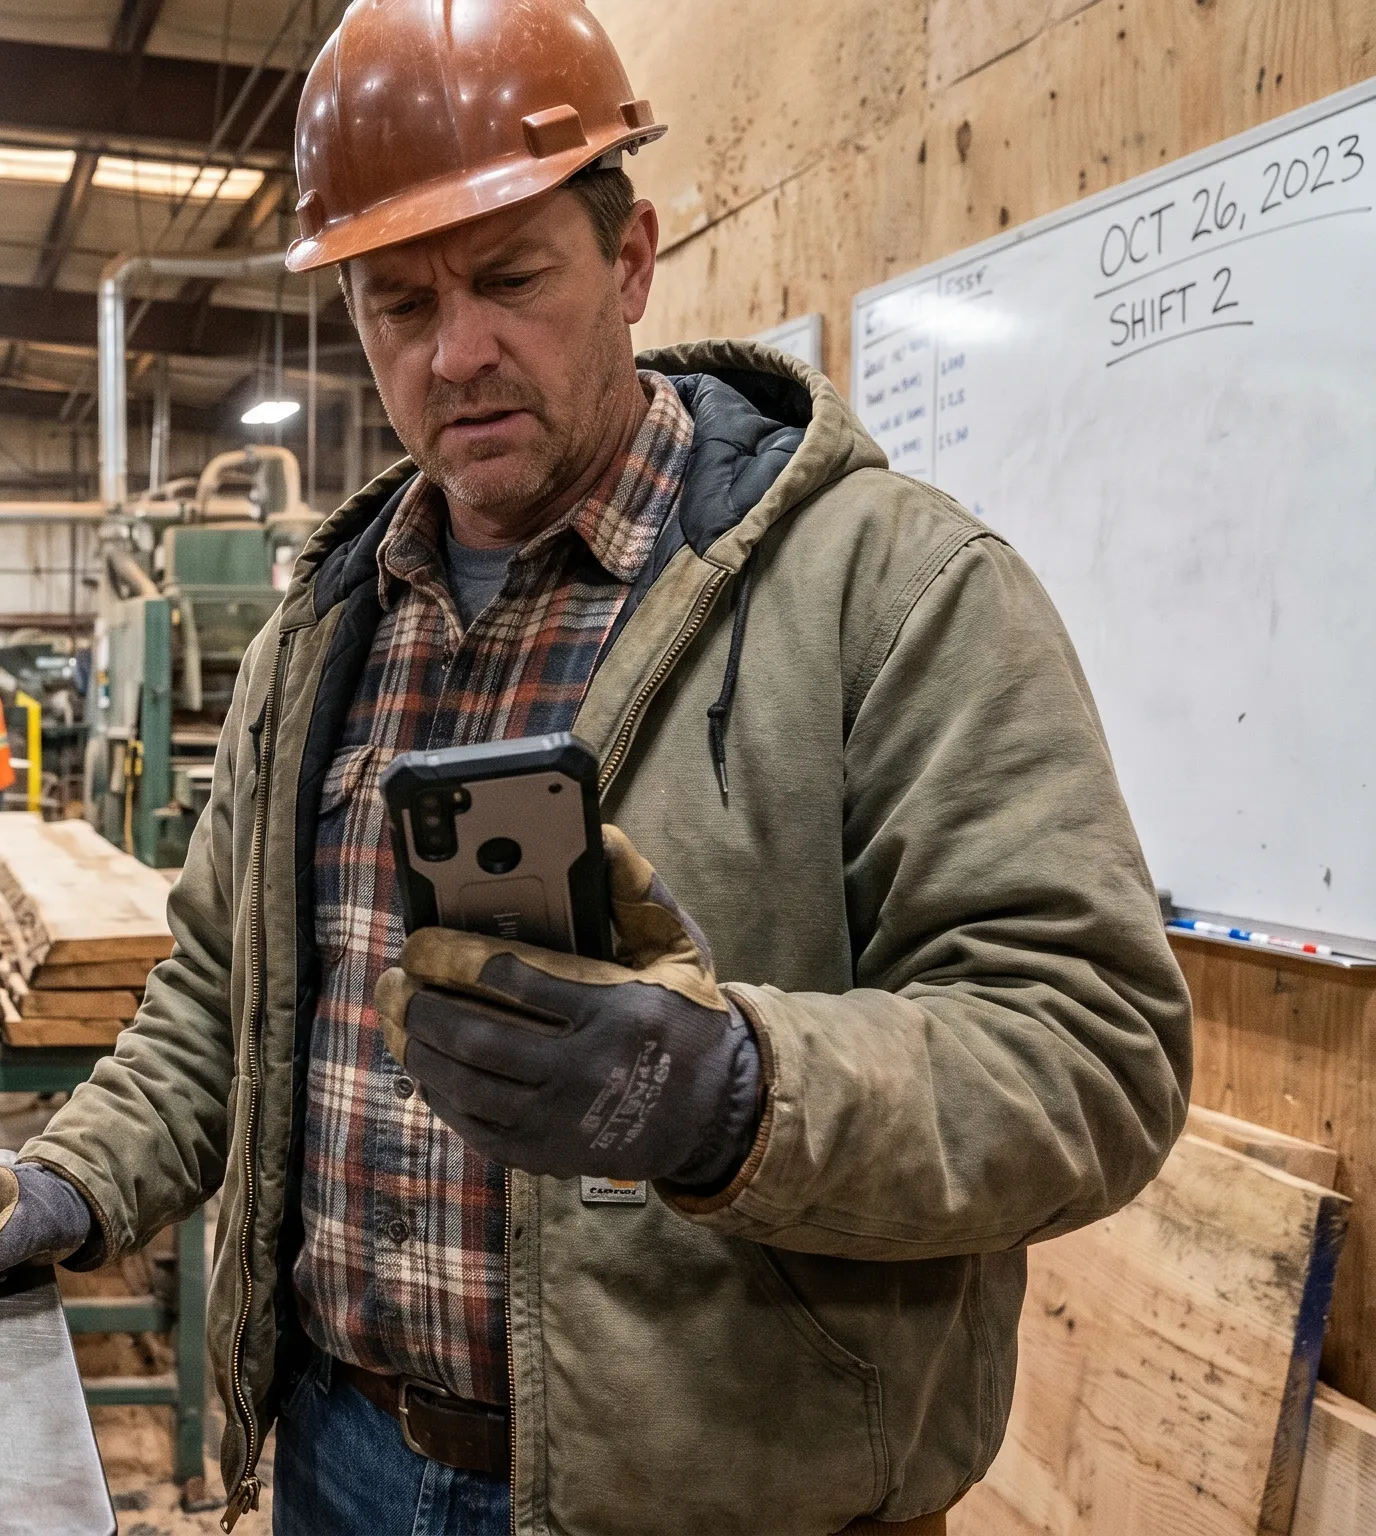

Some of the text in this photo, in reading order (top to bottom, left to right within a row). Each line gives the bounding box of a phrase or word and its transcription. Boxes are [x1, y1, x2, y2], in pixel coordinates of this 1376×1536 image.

[1100, 134, 1364, 278] OCT 26, 2023
[1110, 267, 1239, 347] SHIFT 2
